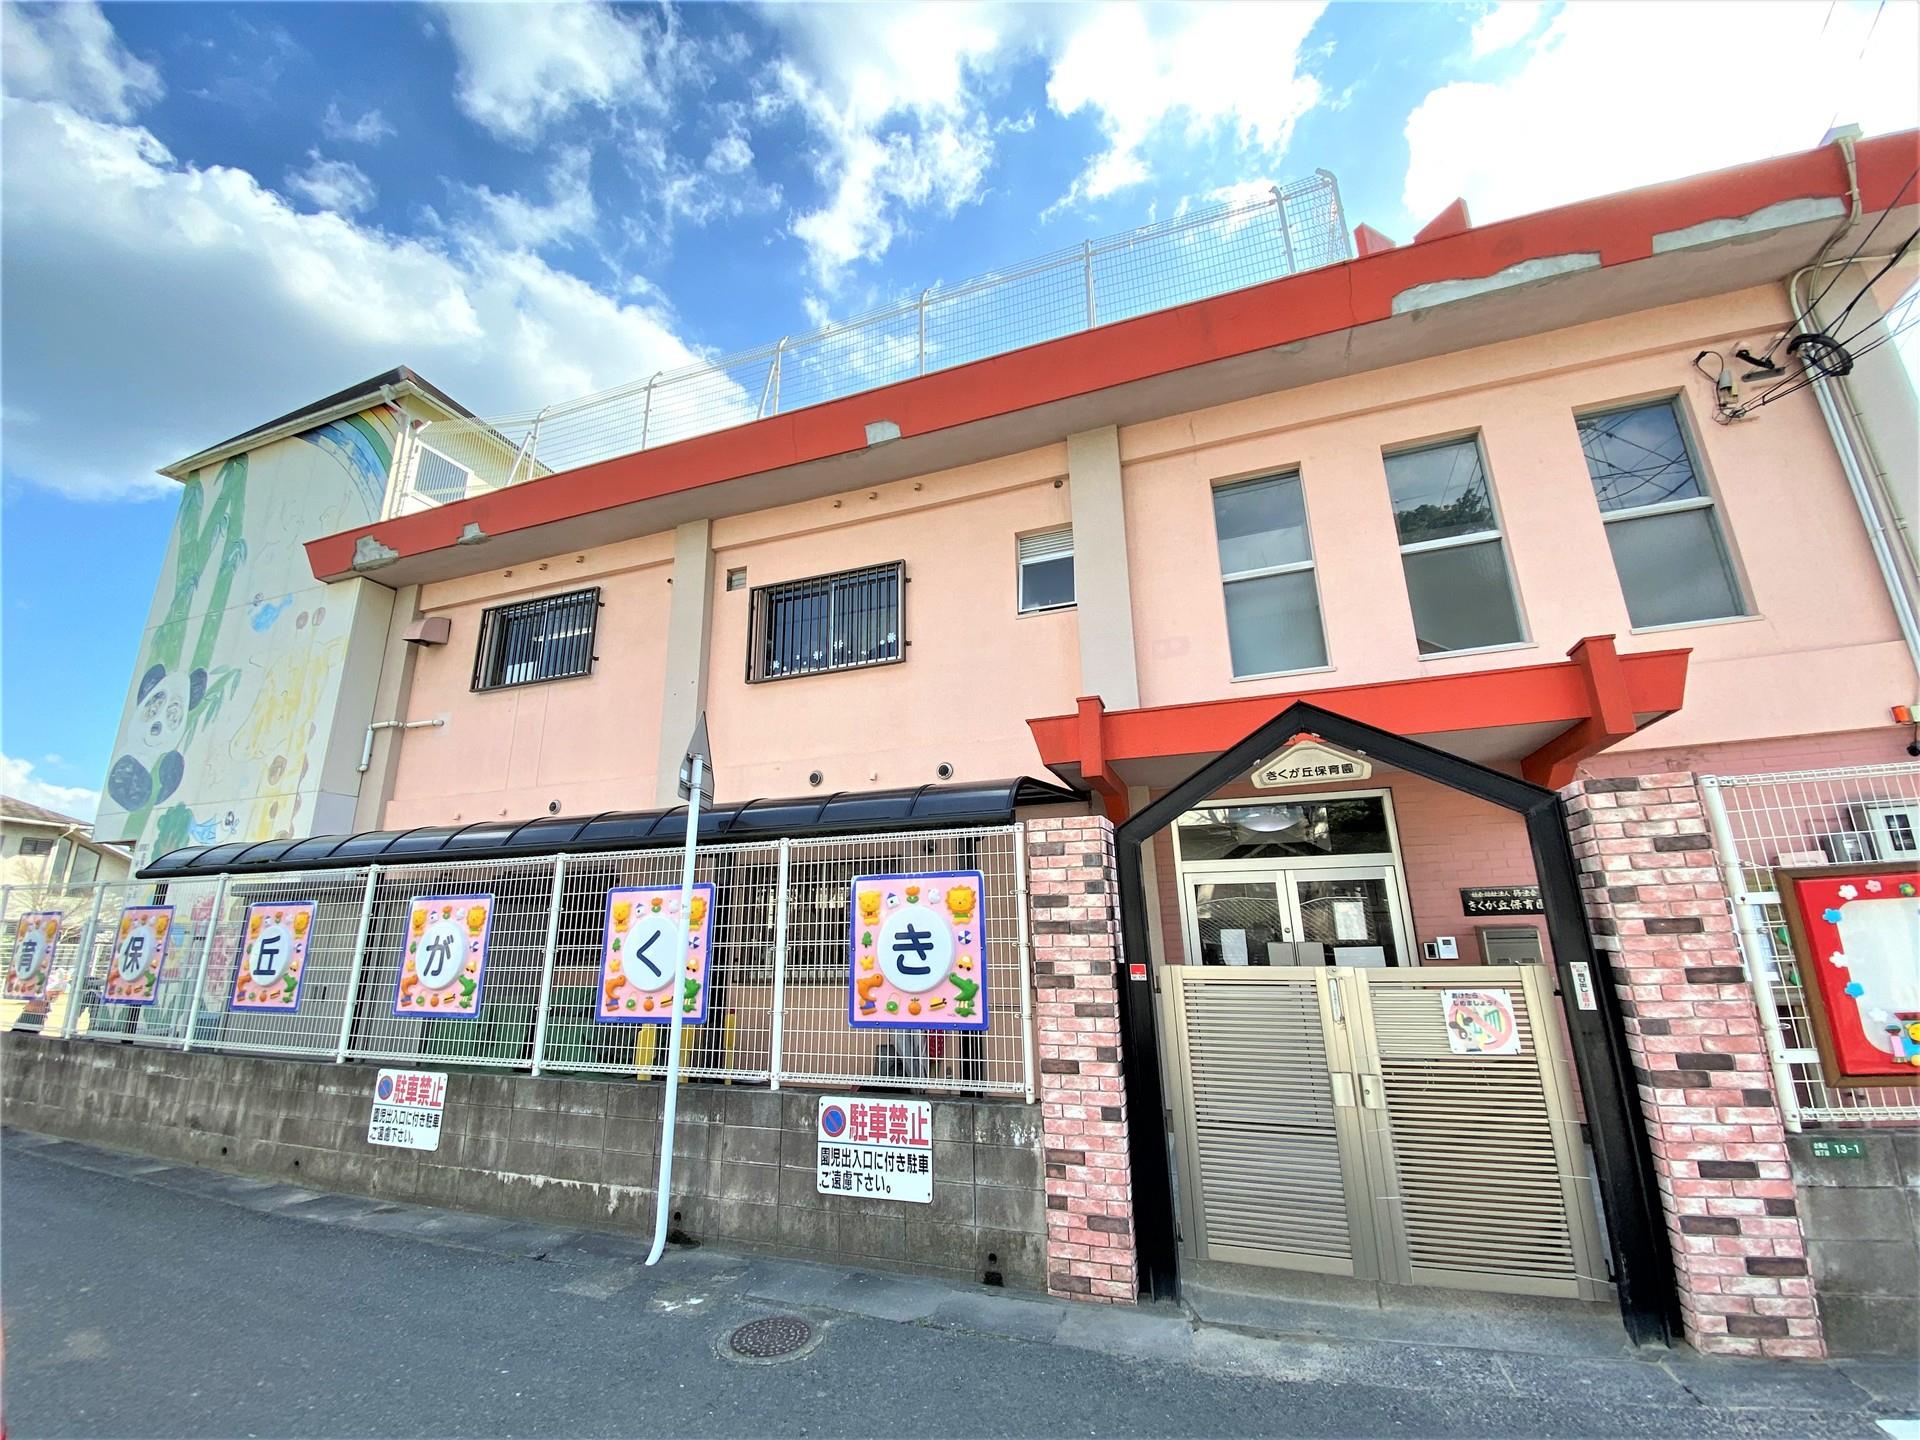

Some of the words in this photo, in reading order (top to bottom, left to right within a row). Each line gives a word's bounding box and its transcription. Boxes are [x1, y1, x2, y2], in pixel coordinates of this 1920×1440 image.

[1265, 763, 1354, 781] きくが丘保育園
[18, 938, 38, 973] 育
[122, 936, 145, 974] 保
[252, 935, 282, 976] 丘
[422, 934, 455, 977] が
[635, 928, 663, 978] く
[892, 922, 935, 976] き
[393, 1074, 443, 1107] 駐車禁止
[369, 1126, 414, 1144] ご遠慮下さい。
[372, 1107, 440, 1129] 園児出入口に付き駐車
[849, 1103, 929, 1146] 駐車禁止
[820, 1147, 929, 1175] 園児出入口に付き駐車
[1834, 1144, 1860, 1154] 13-1
[820, 1169, 891, 1194] ご遠慮下さい。
